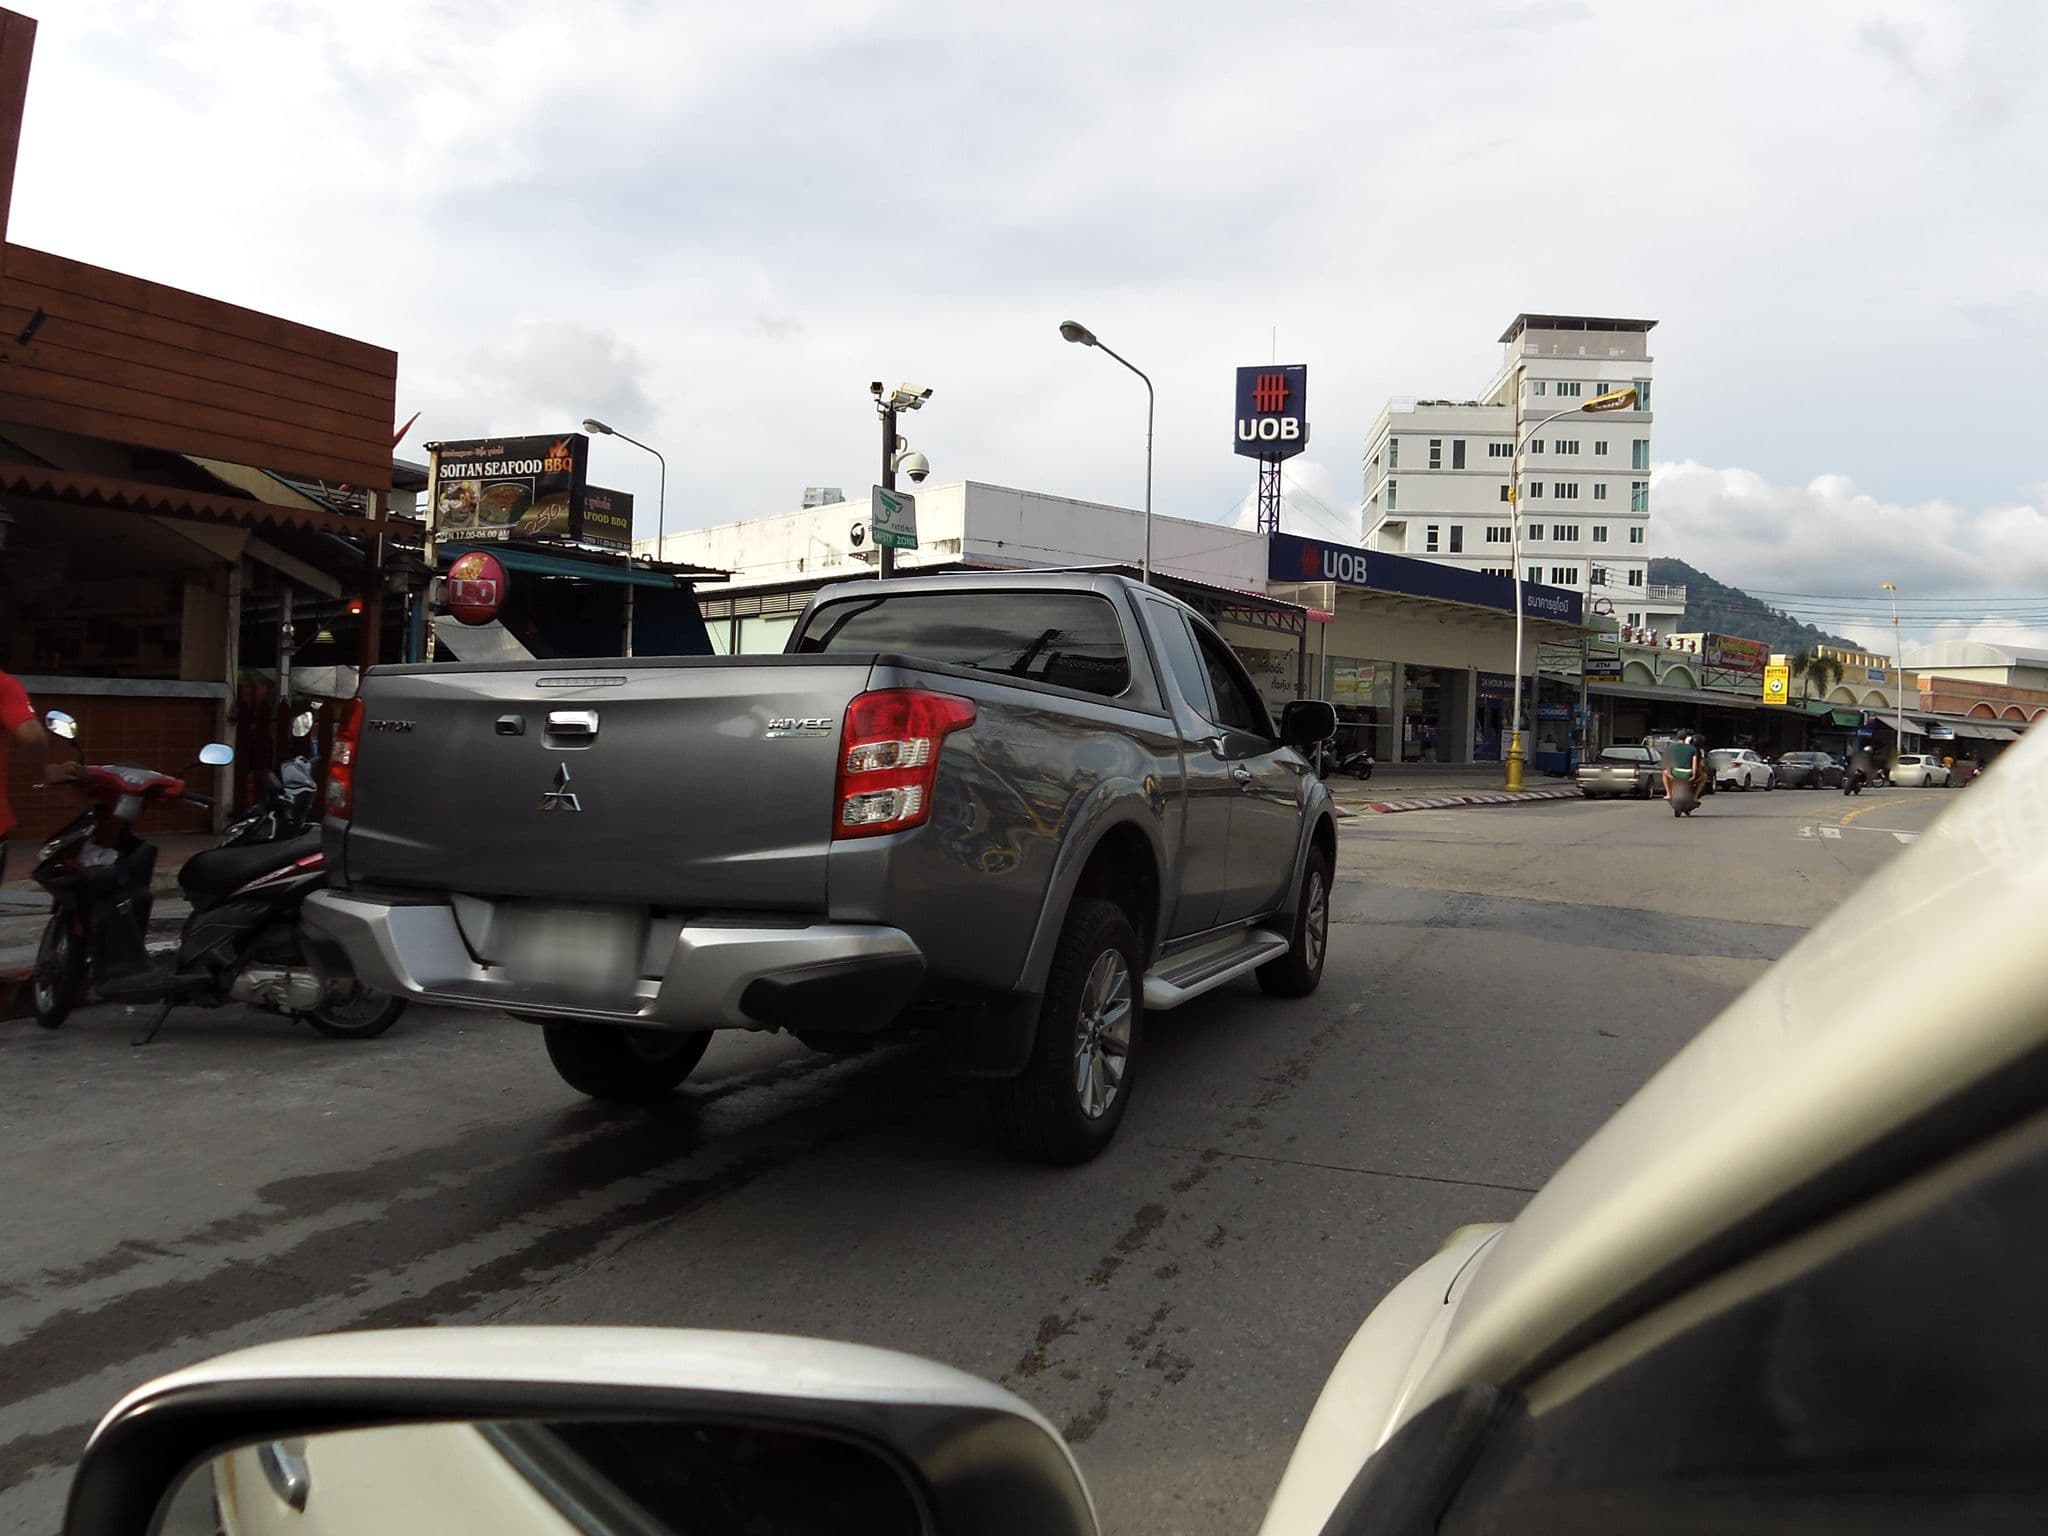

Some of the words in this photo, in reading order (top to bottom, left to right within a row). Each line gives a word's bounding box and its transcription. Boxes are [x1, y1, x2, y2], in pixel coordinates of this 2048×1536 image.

[1239, 417, 1300, 441] UOB
[440, 463, 483, 478] SOITAN
[484, 459, 542, 476] SEAFOOD
[544, 457, 573, 473] BBQ
[1323, 549, 1368, 584] UOB
[767, 718, 833, 730] MIVEC
